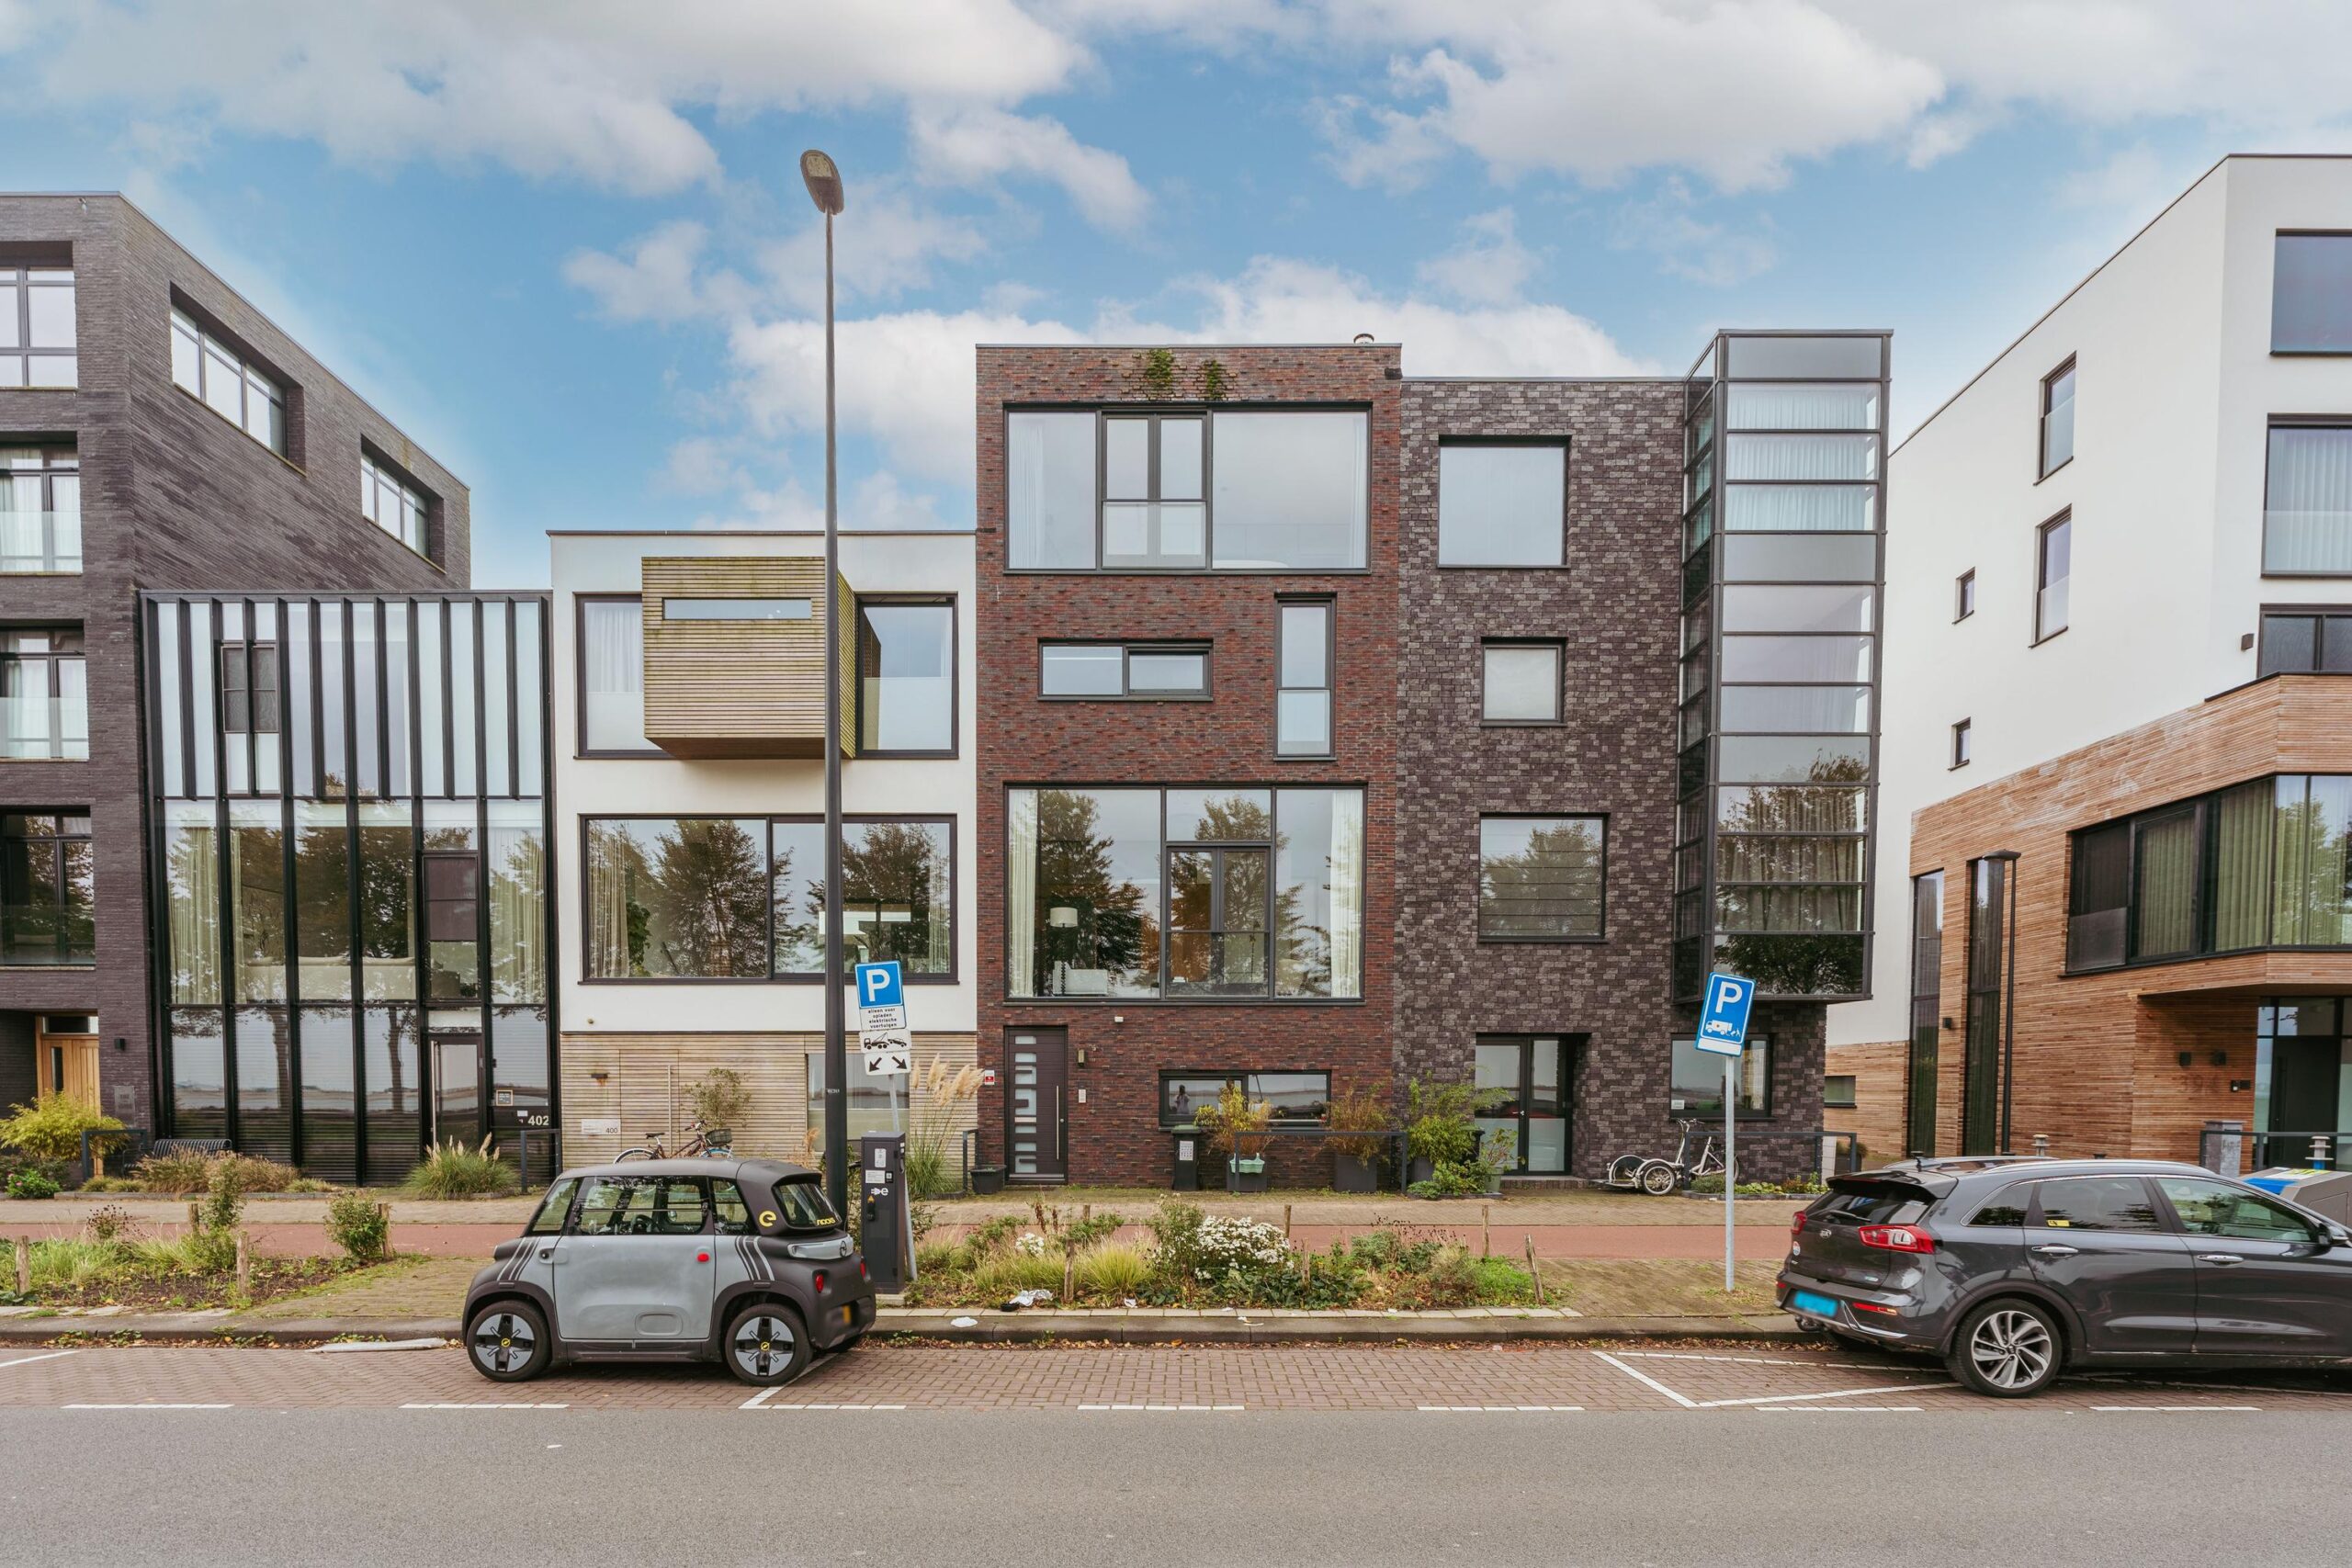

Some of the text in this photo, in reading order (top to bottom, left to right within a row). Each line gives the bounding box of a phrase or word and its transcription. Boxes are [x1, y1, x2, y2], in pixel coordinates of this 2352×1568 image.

[866, 969, 890, 1002] P
[1715, 981, 1743, 1013] P
[527, 1115, 549, 1126] 402
